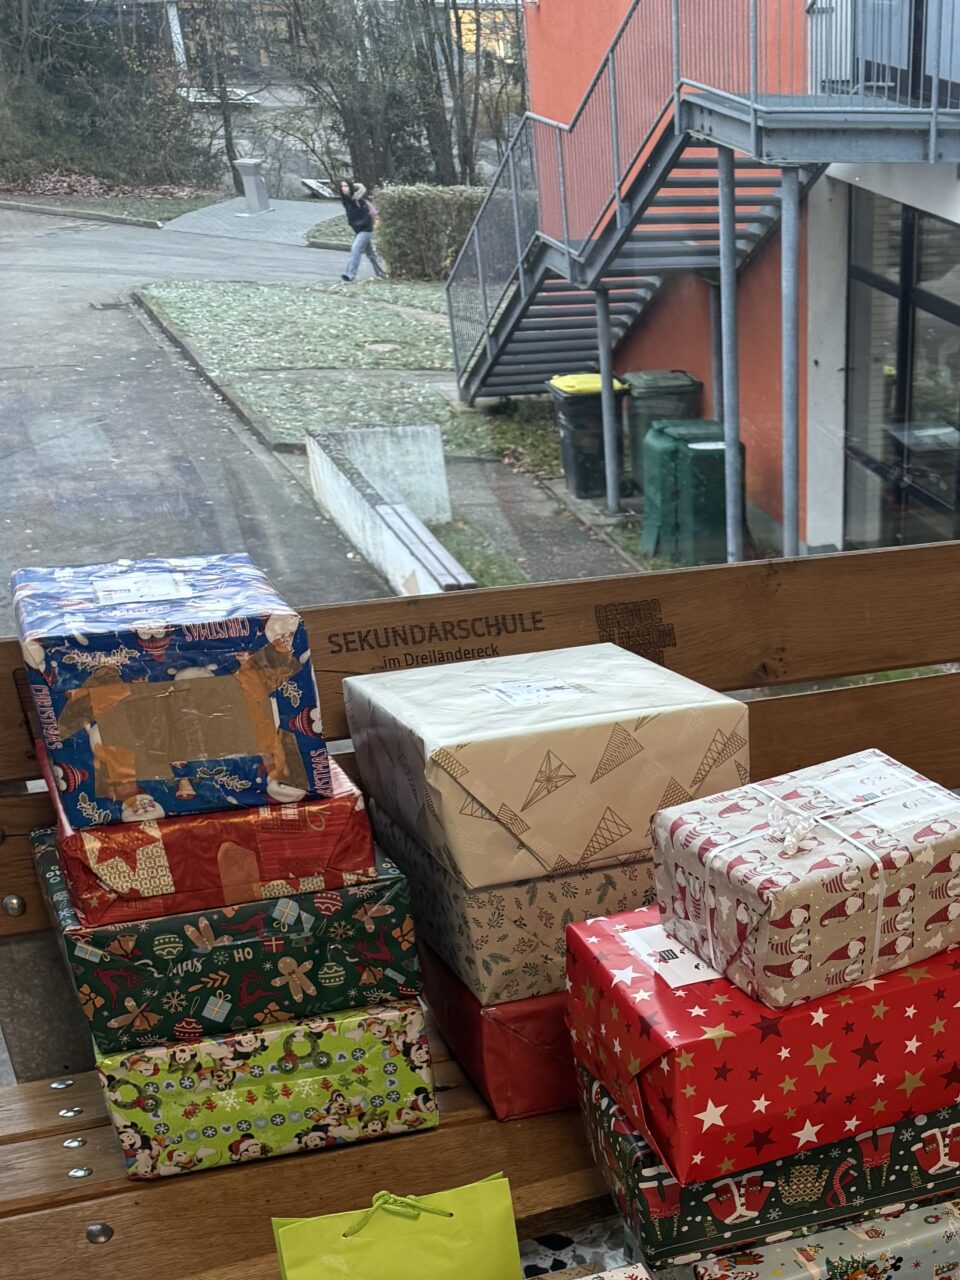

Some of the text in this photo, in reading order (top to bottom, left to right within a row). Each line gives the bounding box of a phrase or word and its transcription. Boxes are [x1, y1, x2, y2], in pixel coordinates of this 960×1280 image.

[182, 616, 250, 642] CHRISTMAS
[327, 610, 545, 654] SEKUNDARSCHULE
[383, 643, 499, 669] im Dreiländereck
[31, 684, 62, 750] CHRISTMAS
[234, 948, 253, 964] HO
